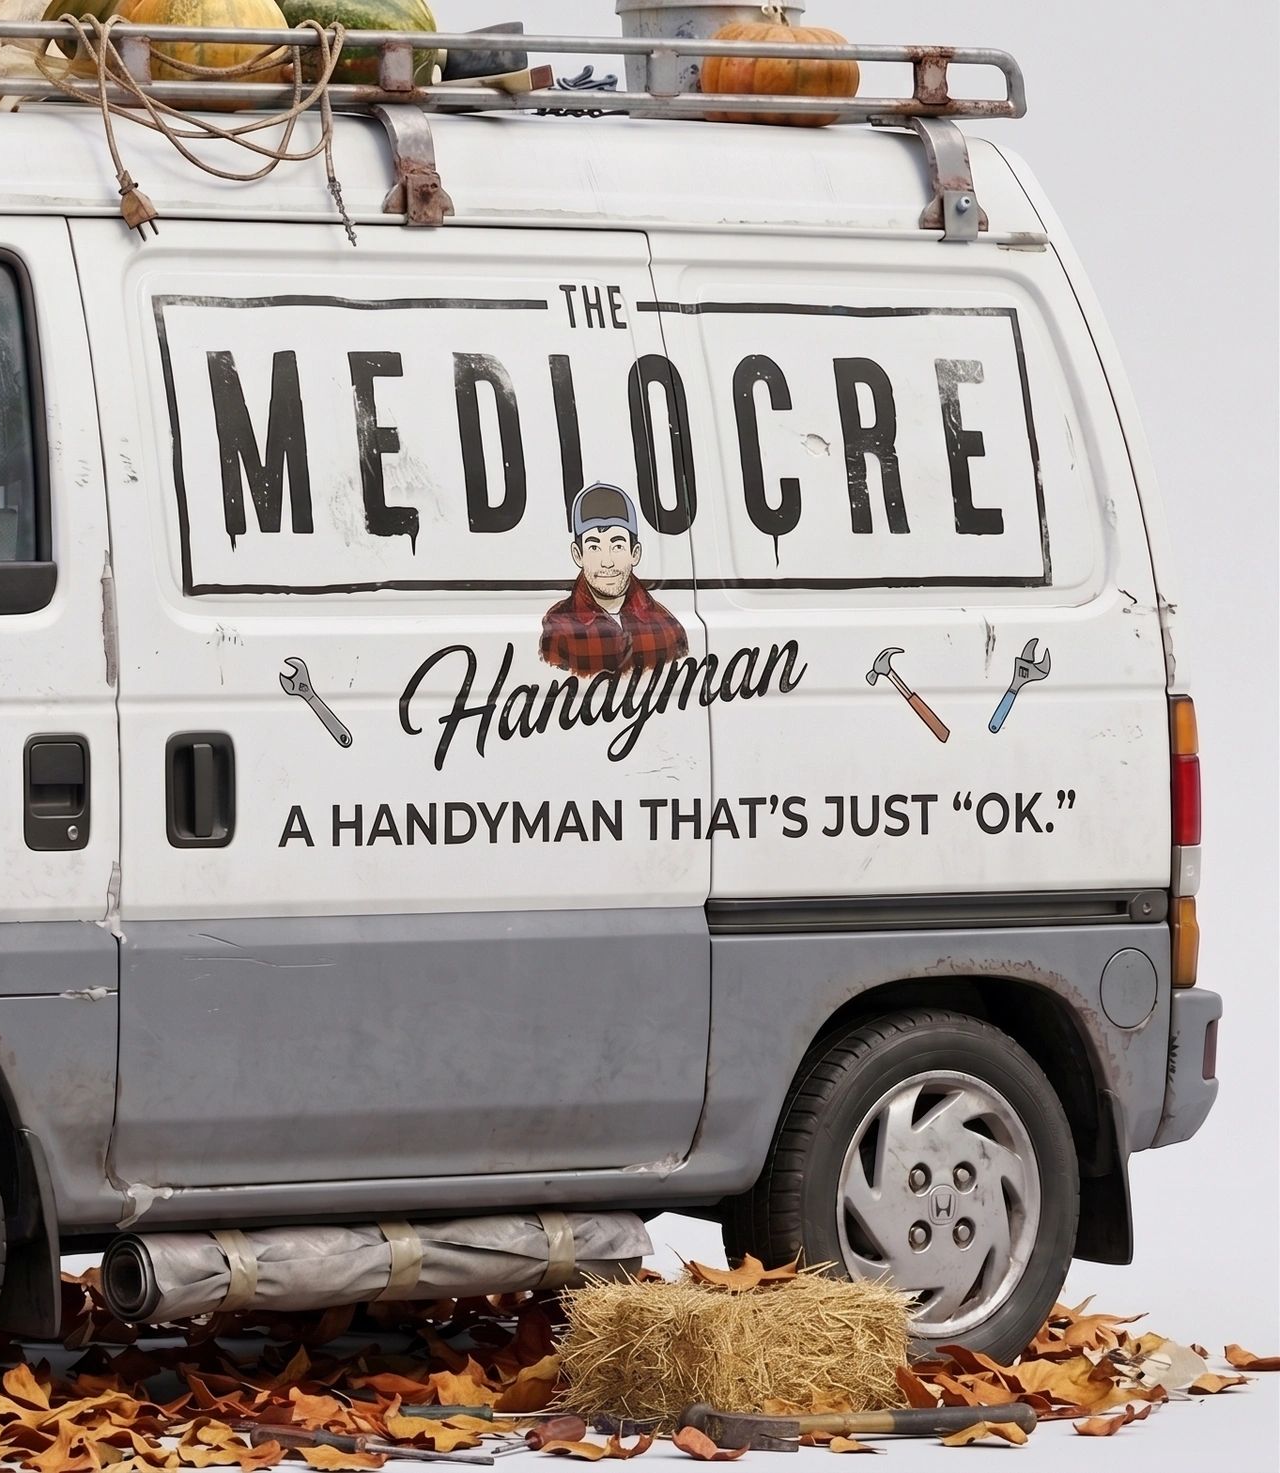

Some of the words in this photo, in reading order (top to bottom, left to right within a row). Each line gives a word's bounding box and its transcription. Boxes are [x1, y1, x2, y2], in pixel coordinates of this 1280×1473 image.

[557, 284, 629, 330] THE
[206, 350, 1006, 552] MEDIOCRE
[278, 805, 315, 848] A
[332, 798, 623, 847] HANDYMAN
[639, 794, 809, 842] THAT’S
[821, 793, 939, 839] JUST
